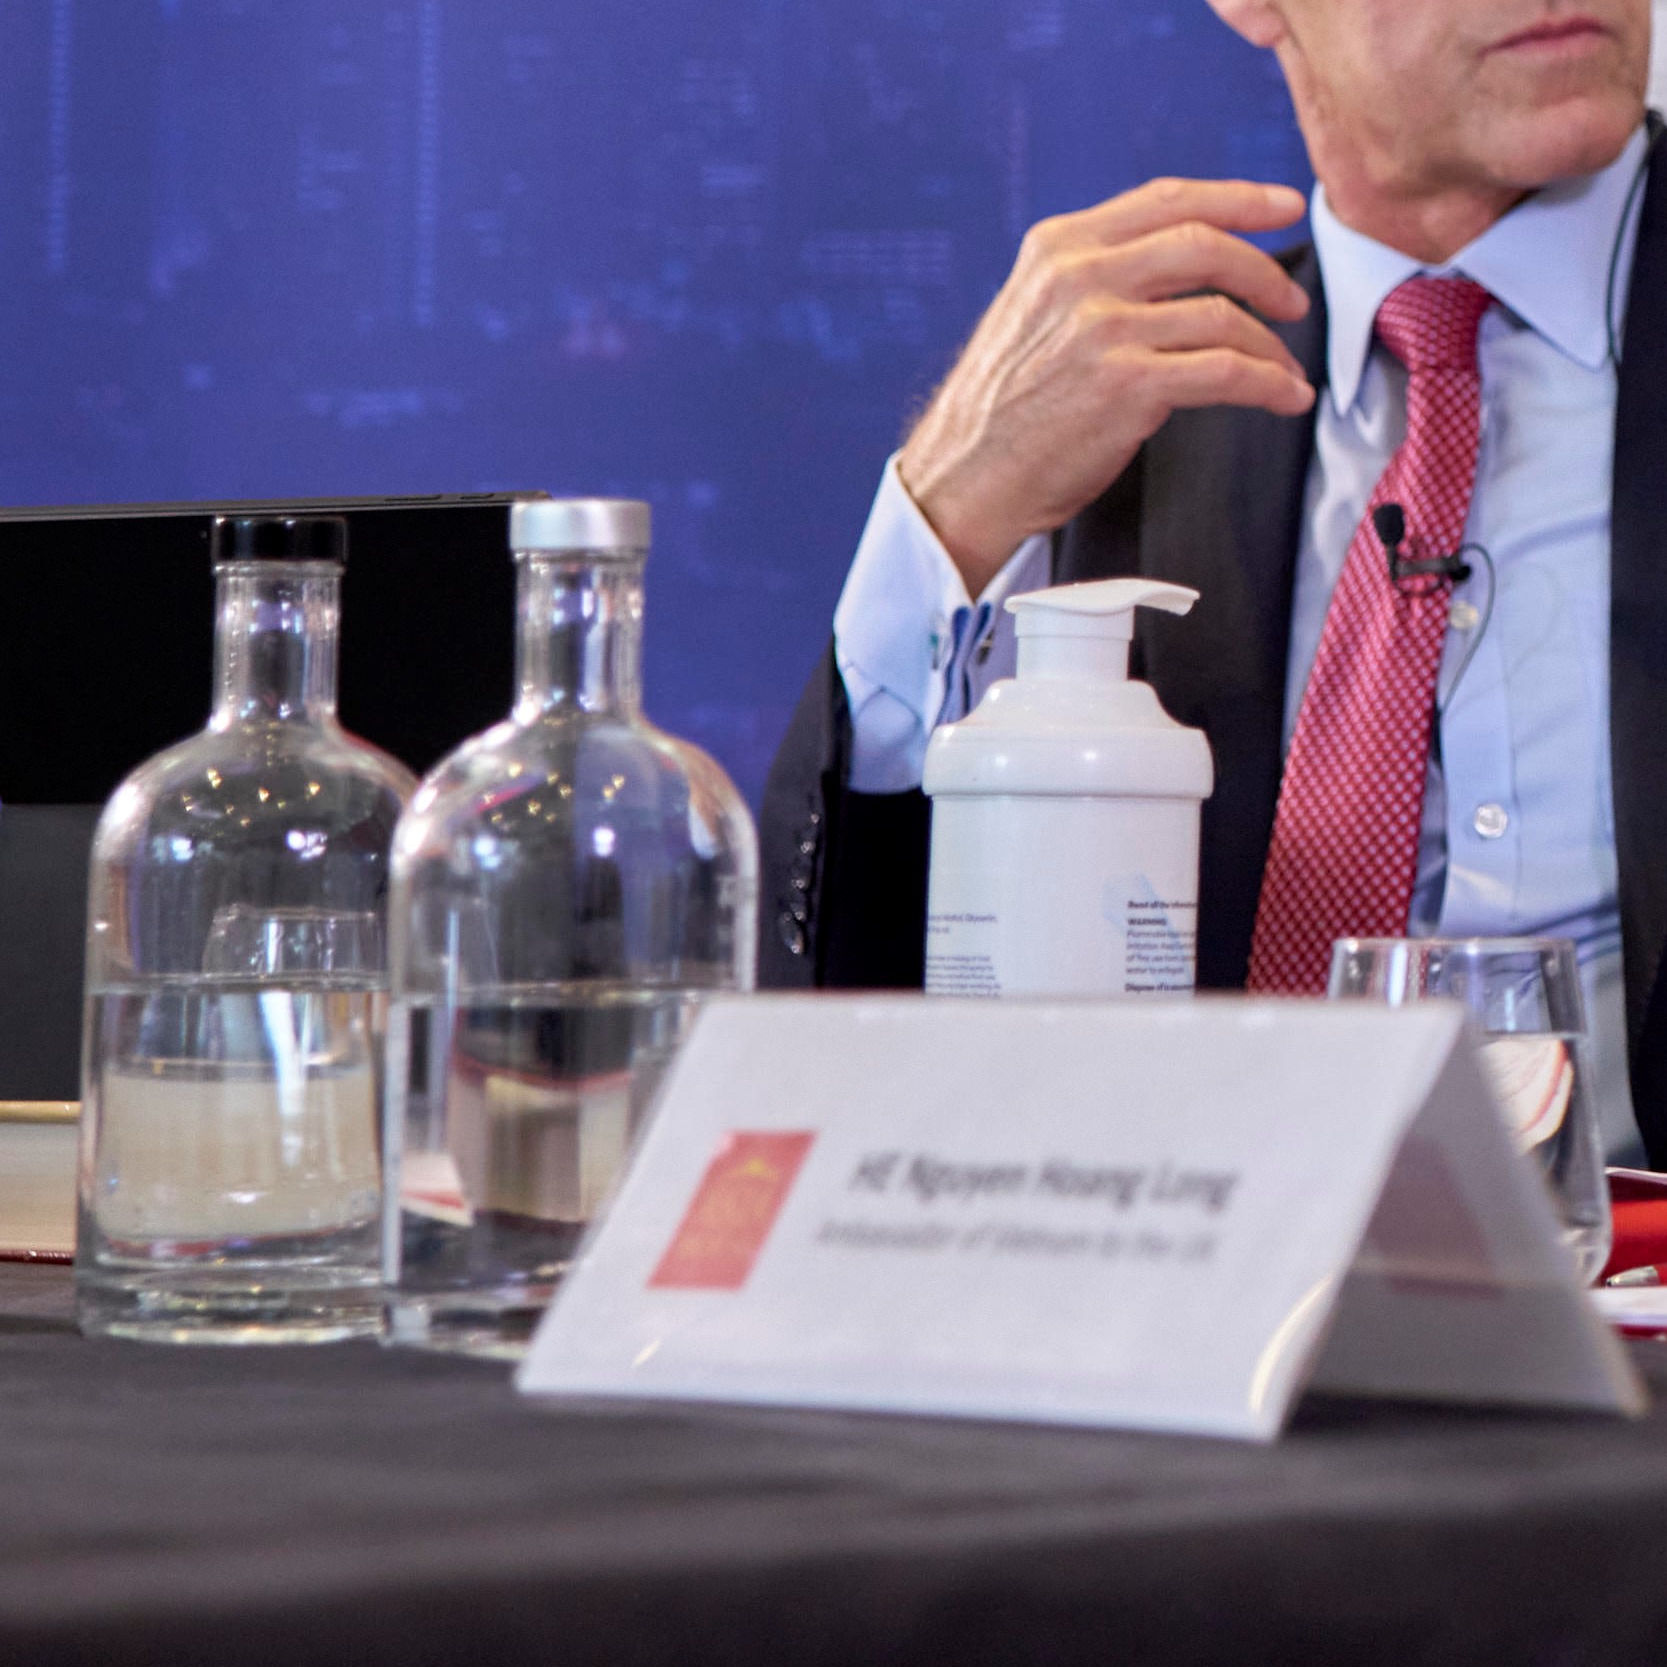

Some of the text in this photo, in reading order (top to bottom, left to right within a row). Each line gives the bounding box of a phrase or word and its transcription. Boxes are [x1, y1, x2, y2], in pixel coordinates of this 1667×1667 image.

[902, 1152, 1028, 1207] Nguyen
[1033, 1154, 1144, 1212] Hoang
[1148, 1156, 1240, 1217] Long
